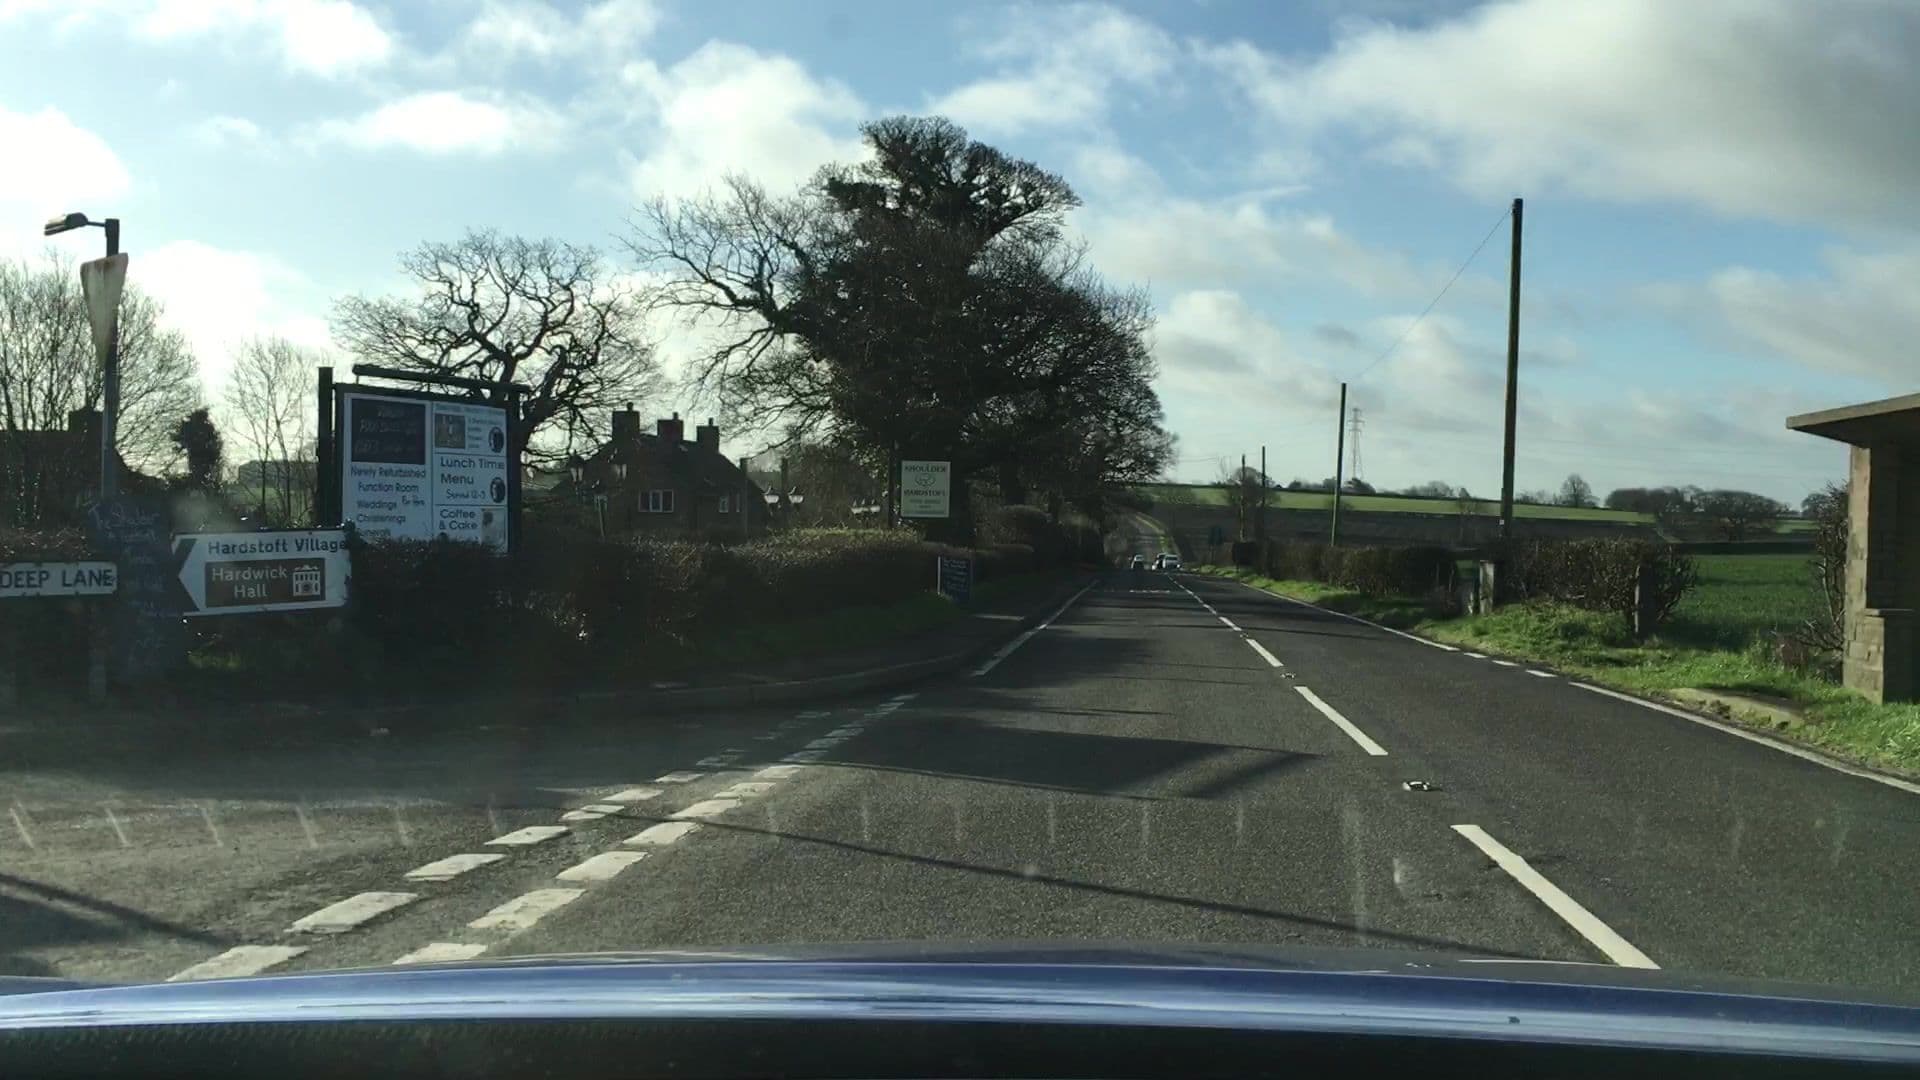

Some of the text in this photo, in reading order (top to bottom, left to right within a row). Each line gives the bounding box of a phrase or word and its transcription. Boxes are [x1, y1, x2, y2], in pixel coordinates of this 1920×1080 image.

[440, 456, 505, 470] Lunch Time
[351, 466, 376, 479] Newly
[440, 473, 474, 485] Menu
[358, 481, 419, 493] Function Room
[357, 500, 397, 511] Weddings
[440, 509, 476, 519] Coffee
[449, 520, 478, 530] Cake
[208, 538, 346, 555] Hardstoft Village
[0, 569, 113, 589] DEEP LANE
[212, 564, 287, 582] Hardwick
[234, 583, 267, 599] Hall
